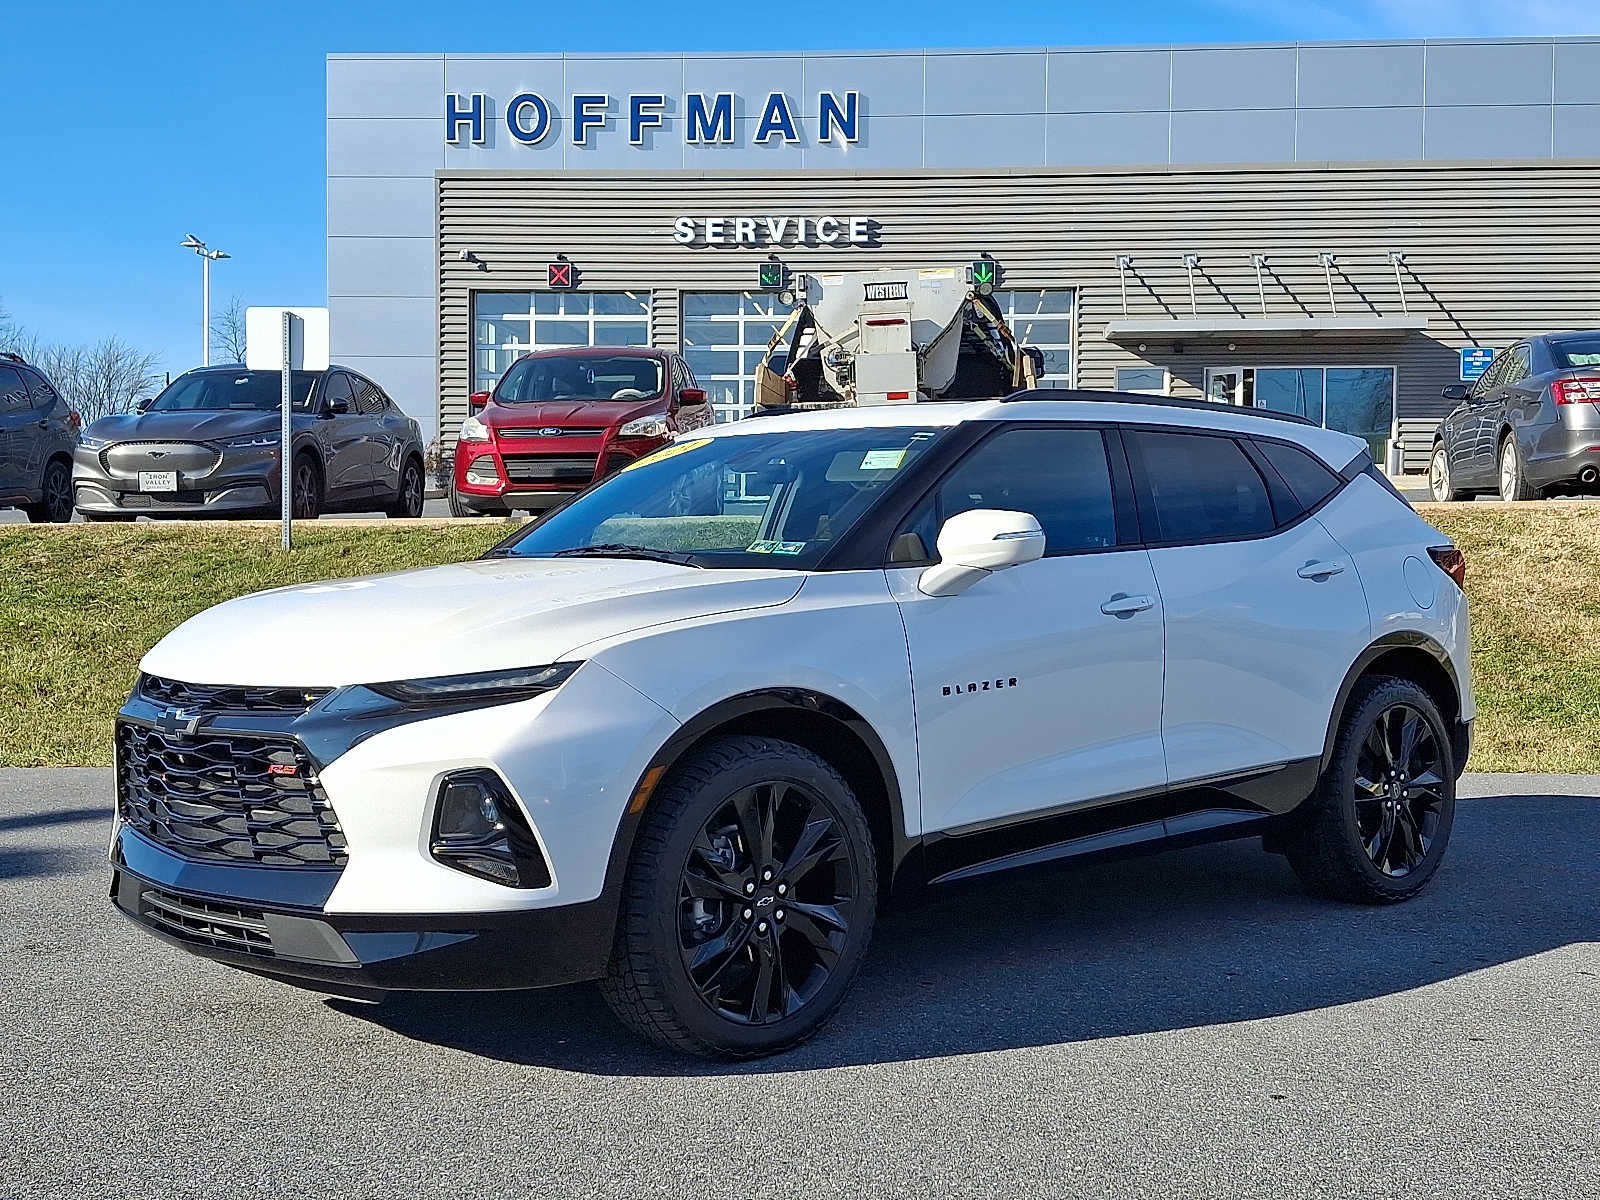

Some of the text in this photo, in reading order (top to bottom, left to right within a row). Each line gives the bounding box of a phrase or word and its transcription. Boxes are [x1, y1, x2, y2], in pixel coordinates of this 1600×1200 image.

[445, 90, 860, 145] HOFFMAN
[673, 216, 869, 243] SERVICE
[866, 284, 906, 299] WESTERN
[942, 677, 1018, 696] BLAZER
